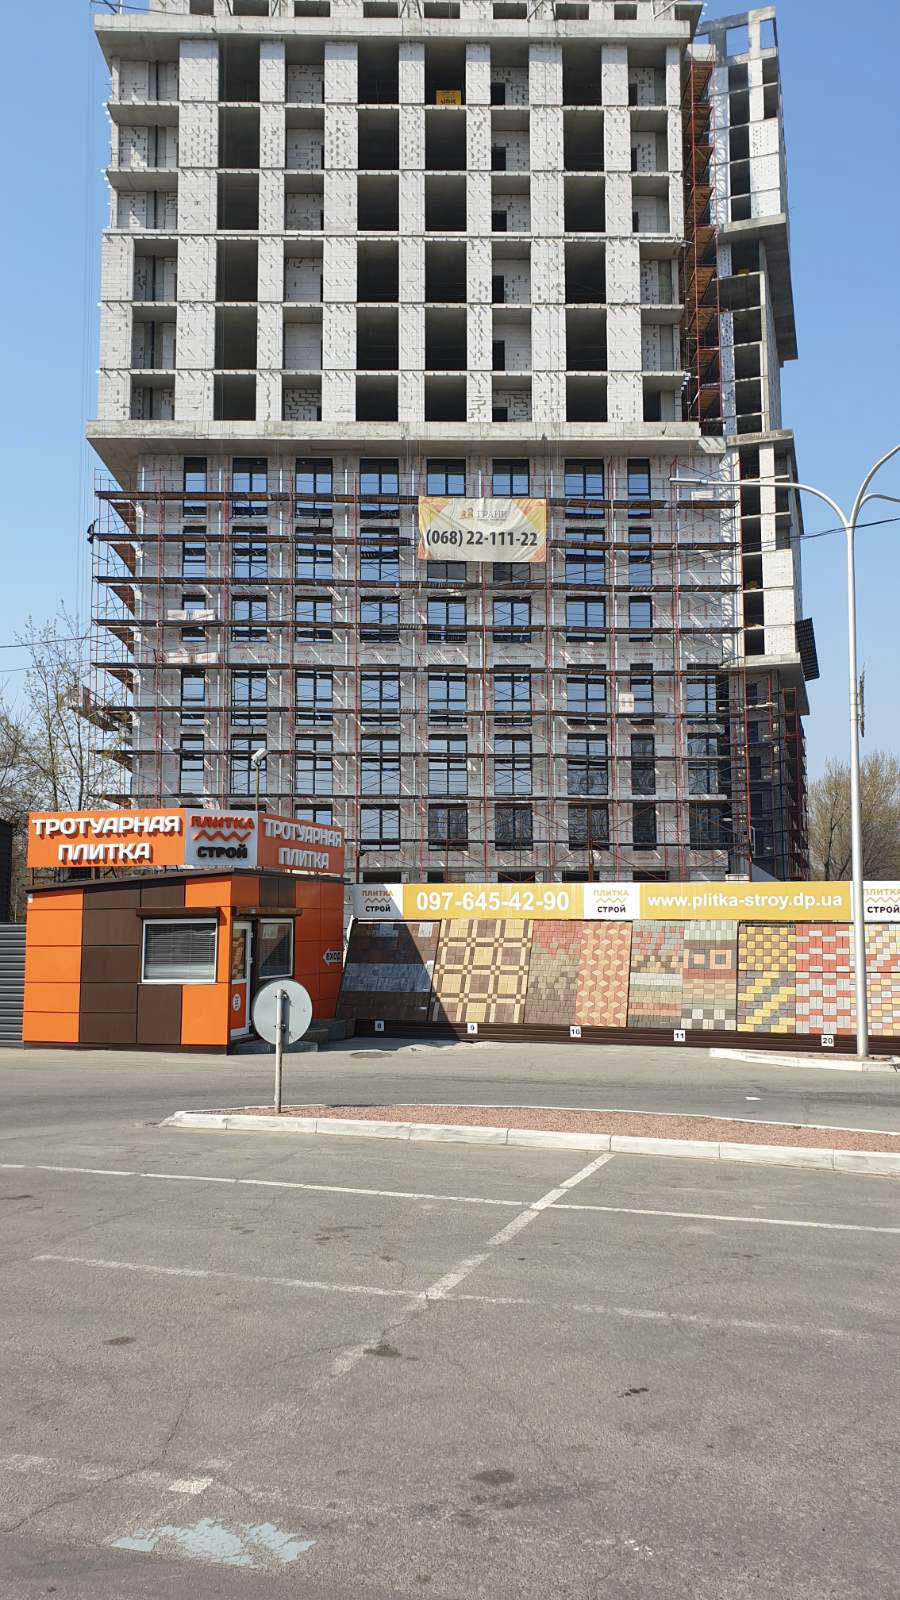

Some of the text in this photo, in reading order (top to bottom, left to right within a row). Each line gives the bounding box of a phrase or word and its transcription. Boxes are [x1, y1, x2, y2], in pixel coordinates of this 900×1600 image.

[426, 529, 538, 547] (068) 22-111-22
[31, 815, 182, 837] ТРОТУАРНАЯ
[190, 815, 255, 829] ПЛИТКА
[263, 818, 342, 847] ТРОТУАРНАЯ
[58, 842, 151, 862] ПЛИТКА
[197, 844, 248, 858] СТРОЙ
[278, 847, 329, 869] ПЛИТКА
[362, 889, 394, 897] ПЛИТКА
[416, 891, 569, 911] 097-645-42-90
[593, 889, 629, 897] ПЛИТКА
[365, 904, 391, 913] СТРОЙ
[597, 904, 626, 913] СТРОЙ
[647, 892, 843, 911] www.plitka-stroy.dp.ua
[867, 905, 900, 913] СТРОЙ
